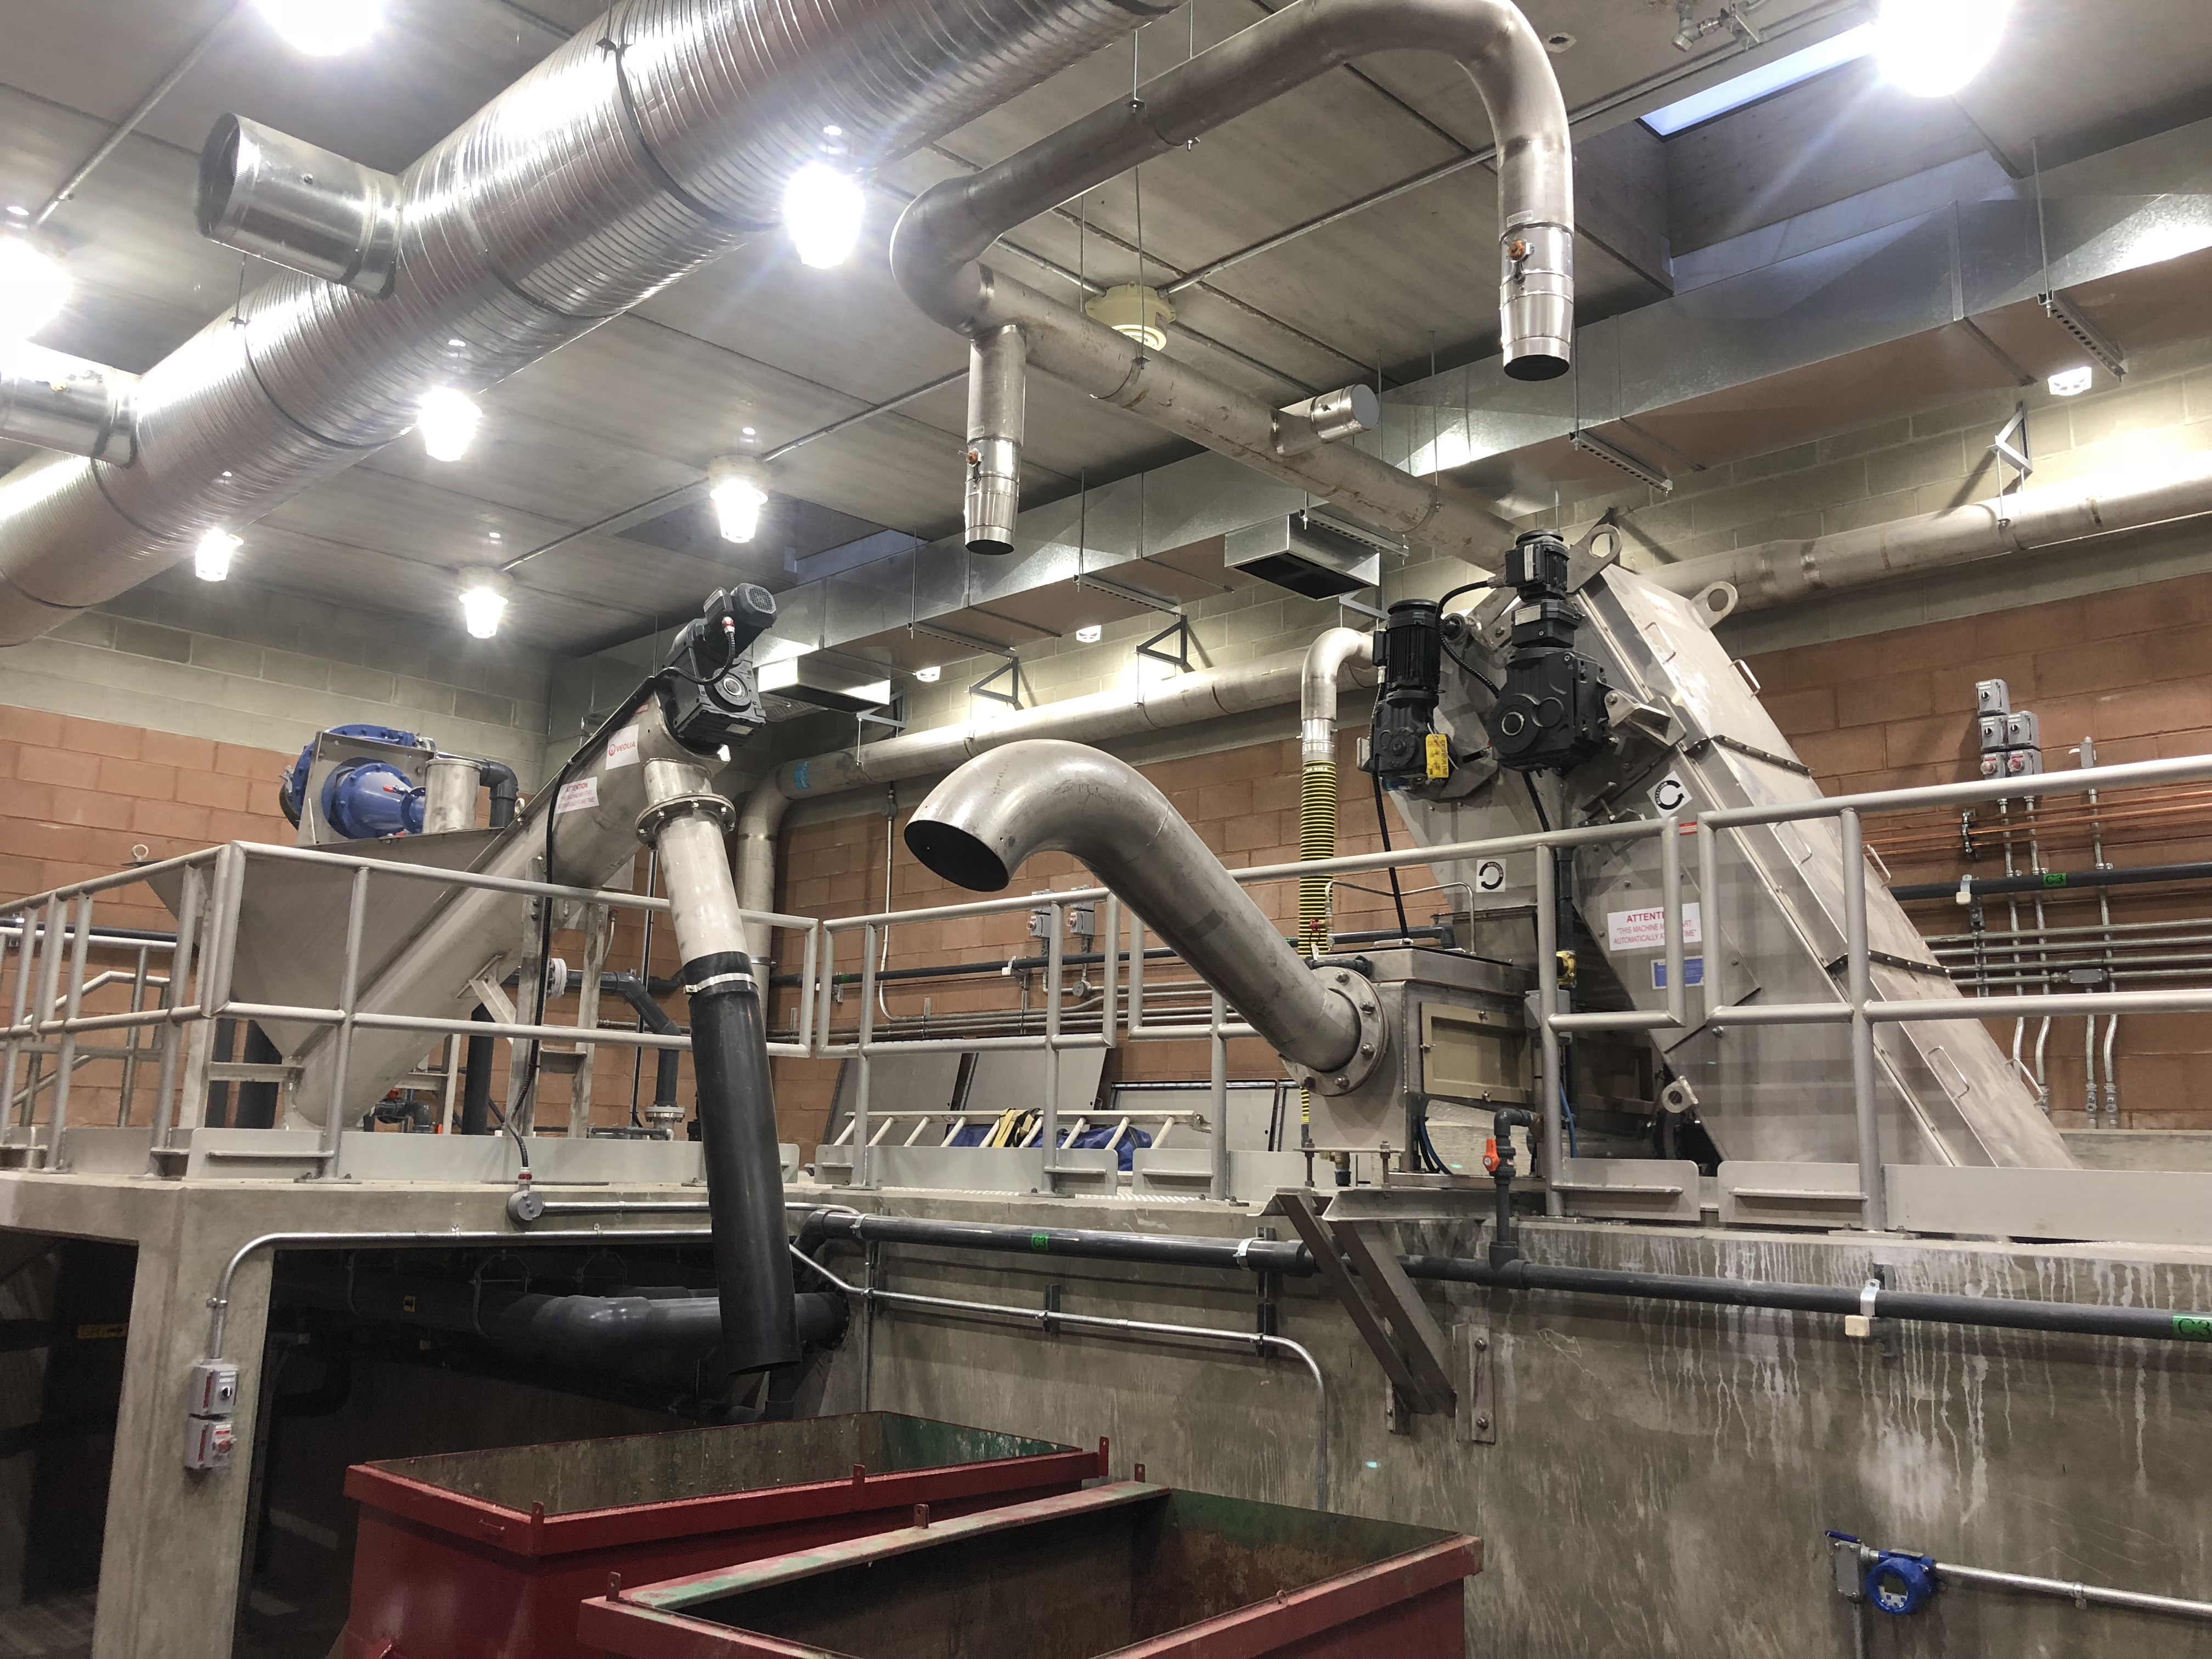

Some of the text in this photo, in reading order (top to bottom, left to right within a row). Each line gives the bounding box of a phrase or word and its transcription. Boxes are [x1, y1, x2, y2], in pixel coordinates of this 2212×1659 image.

[617, 741, 636, 752] VEOLIA
[566, 782, 588, 792] ATTENTION
[1627, 911, 1665, 923] ATTENTI
[1633, 924, 1658, 933] MACHINE
[1613, 934, 1658, 945] AUTOMATICALLY
